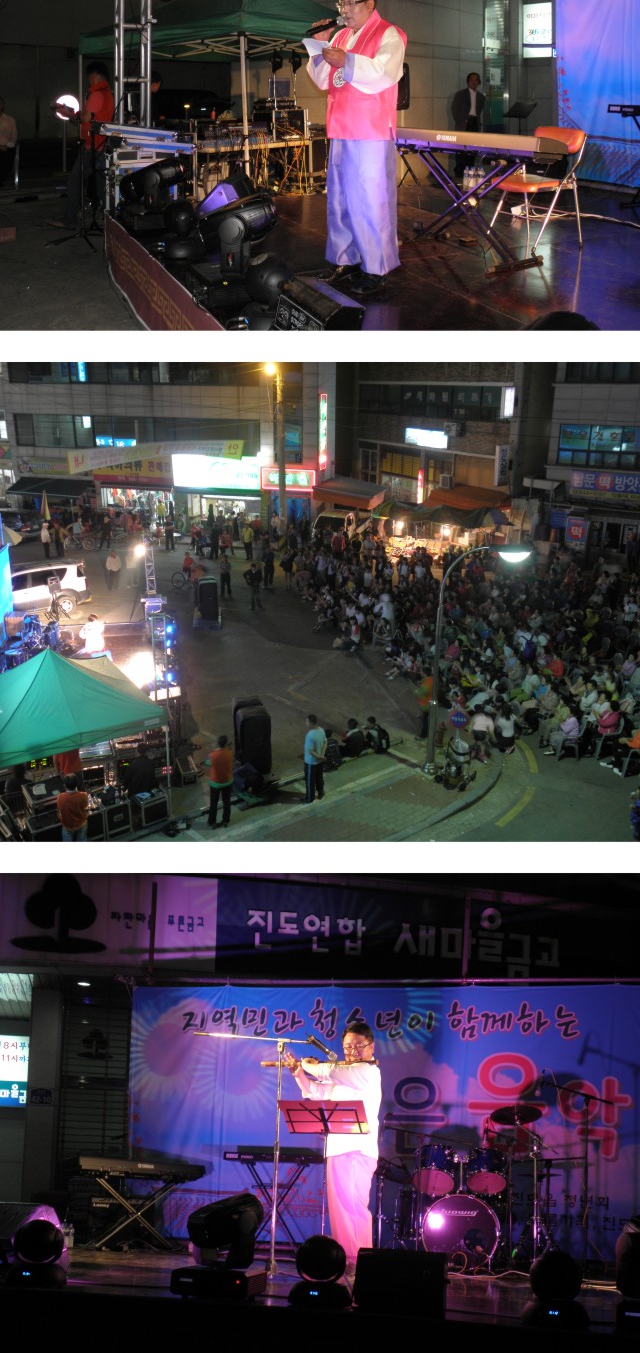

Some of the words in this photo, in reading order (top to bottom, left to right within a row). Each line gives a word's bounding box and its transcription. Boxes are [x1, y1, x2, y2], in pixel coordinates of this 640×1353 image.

[615, 475, 640, 492] 방앗
[110, 910, 152, 930] 파란마
[246, 908, 366, 956] 진도연합
[392, 907, 560, 985] 새마을금고
[182, 1004, 303, 1038] 지역민과
[446, 998, 581, 1040] 함께하는
[386, 1074, 448, 1158] 은
